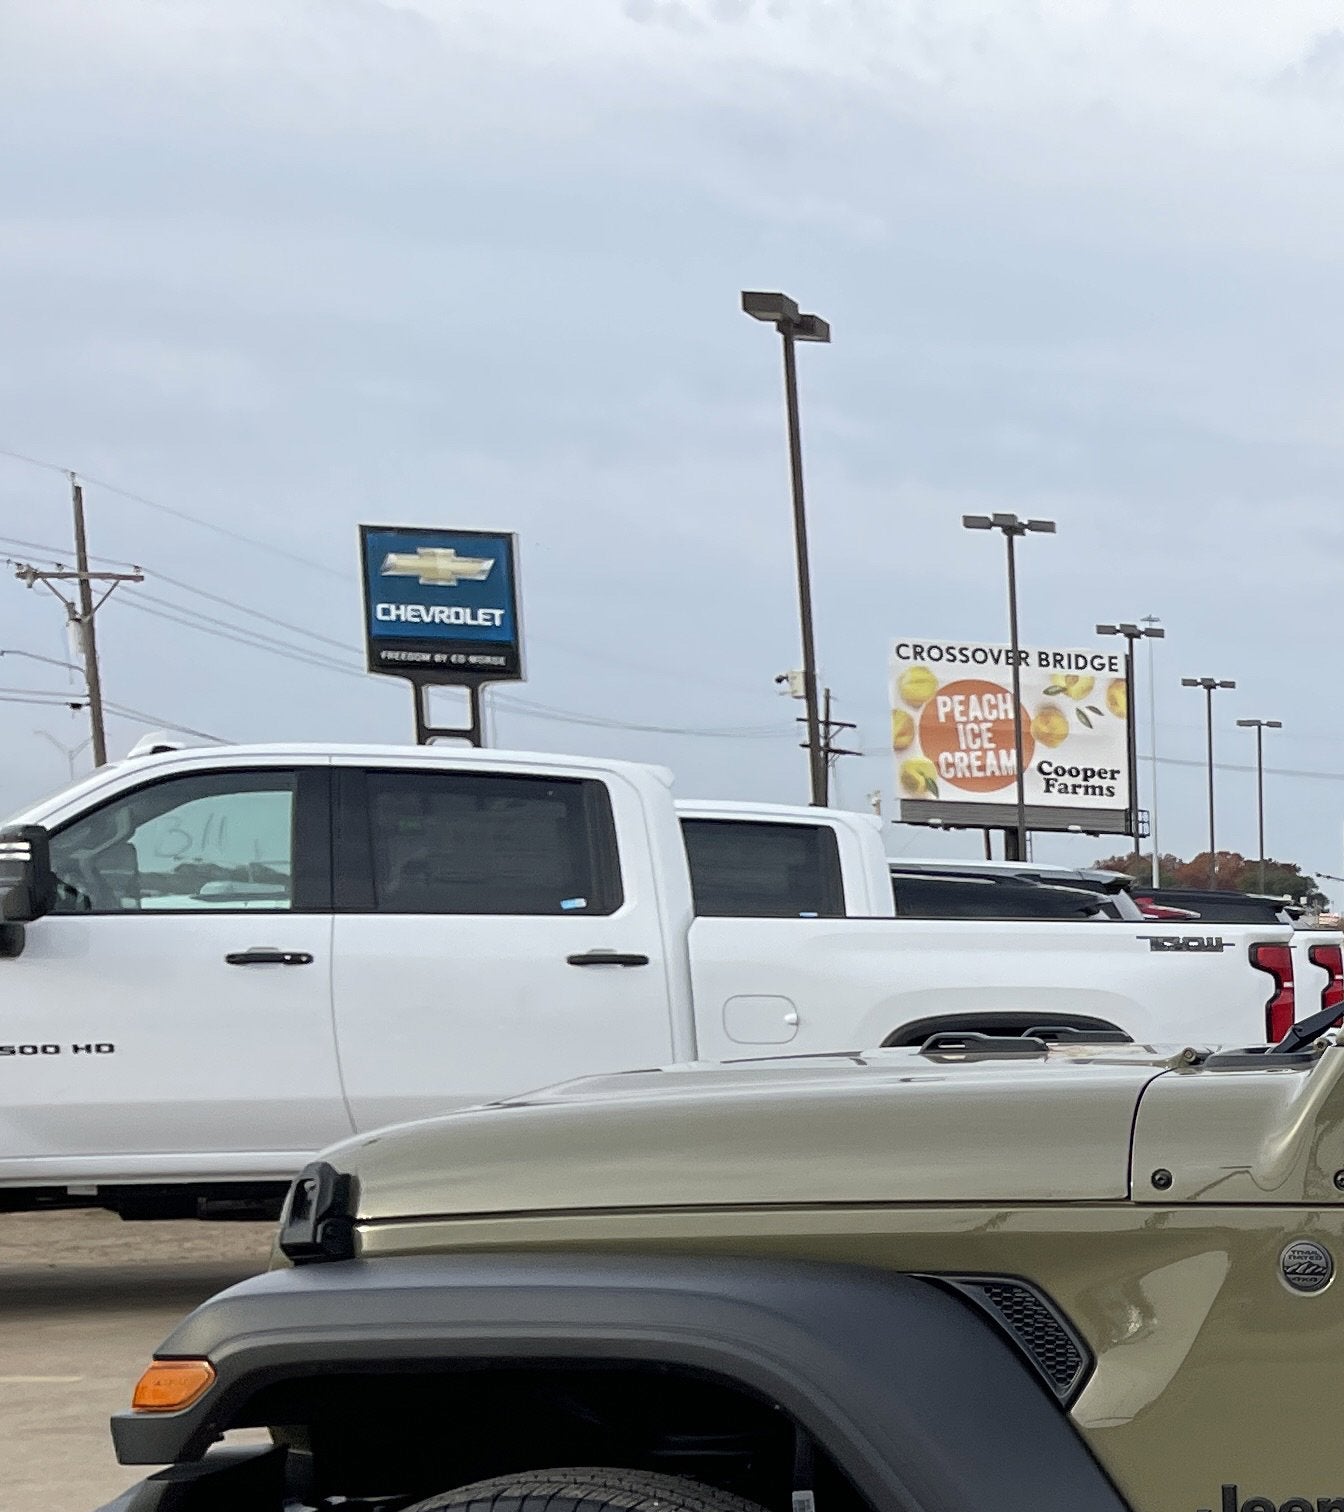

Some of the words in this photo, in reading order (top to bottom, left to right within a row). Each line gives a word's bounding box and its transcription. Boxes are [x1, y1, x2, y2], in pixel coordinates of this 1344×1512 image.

[376, 603, 505, 627] CHEVROLET
[895, 643, 1030, 667] CROSSOVER
[1037, 651, 1119, 673] BRIDGE
[936, 693, 1014, 723] PEACH
[956, 722, 996, 750] ICE
[938, 749, 1018, 778] CREAM
[1036, 760, 1121, 782] Cooper
[1043, 777, 1116, 798] Farms
[72, 1043, 115, 1054] HD
